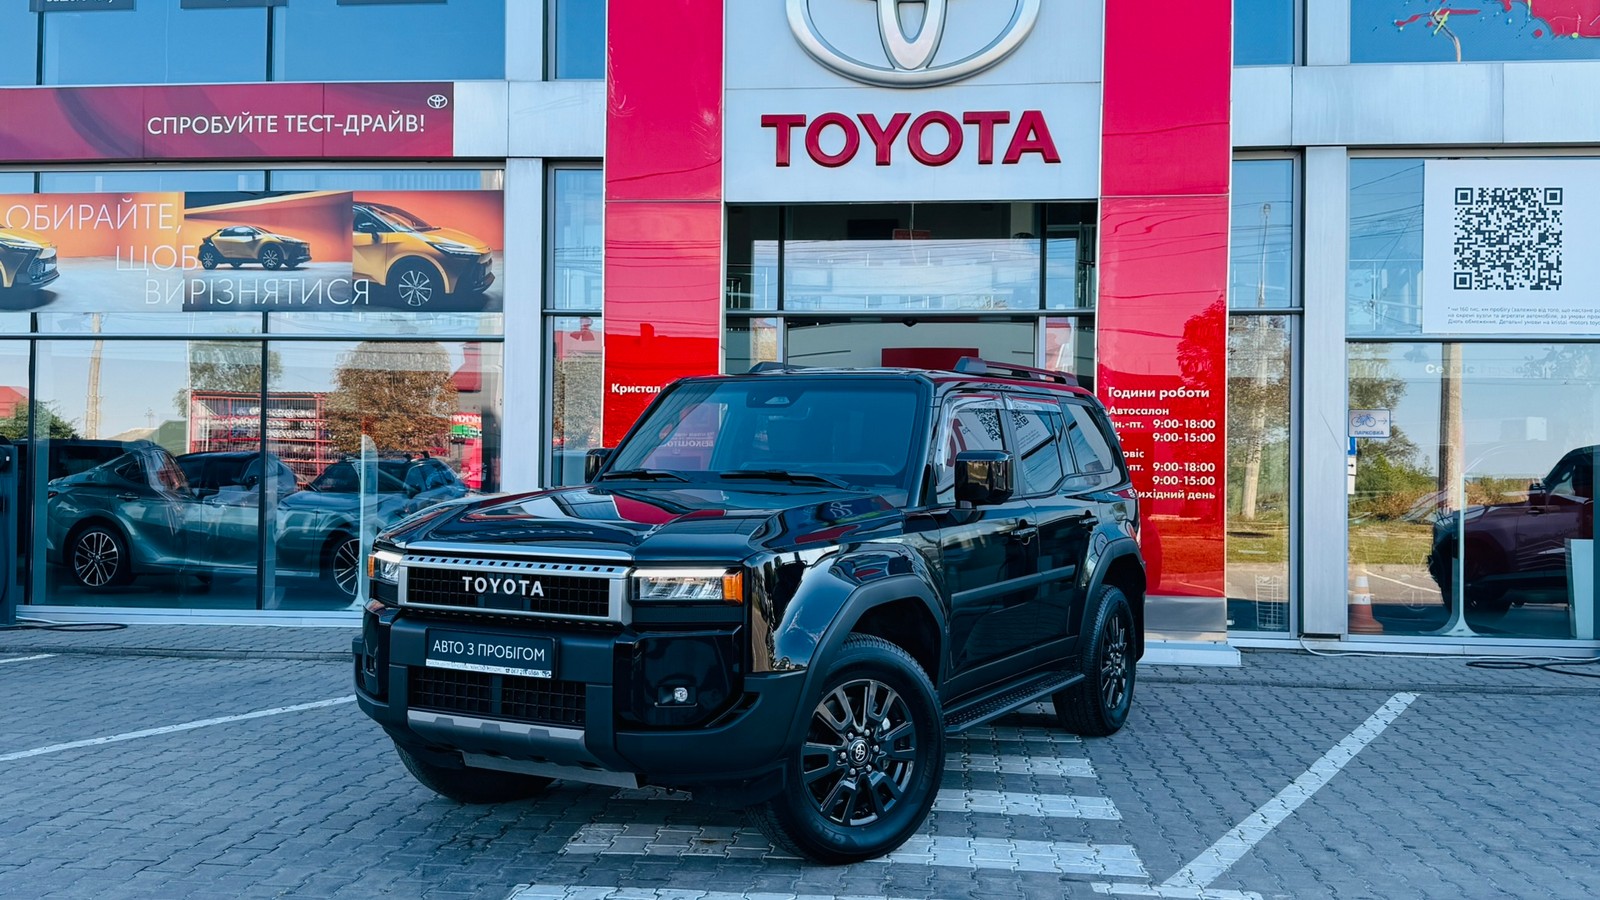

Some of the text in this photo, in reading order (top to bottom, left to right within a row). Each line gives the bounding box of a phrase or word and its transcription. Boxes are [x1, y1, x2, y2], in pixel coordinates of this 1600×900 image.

[147, 110, 425, 136] СПРОБУЙТЕ ТЕСТ-ДРАЙВ!
[761, 110, 1061, 168] TOYOTA
[5, 197, 182, 234] ОБИРАЙТЕ,
[116, 245, 199, 276] ЩОБ
[145, 278, 370, 305] ВИРІЗНЯТИСЯ
[611, 383, 661, 396] Кристал
[1108, 386, 1210, 401] Години роботи
[1109, 405, 1170, 415] Автосалон
[1153, 419, 1216, 429] 9:00-18:00
[1152, 433, 1216, 443] 9:00-15:00
[1153, 462, 1216, 472] 9:00-18:00
[1152, 476, 1216, 486] 9:00-15:00
[1187, 490, 1216, 500] день
[462, 576, 545, 597] TOYOTA
[433, 640, 465, 655] АВТО
[478, 643, 545, 661] ПРОБІГОМ
